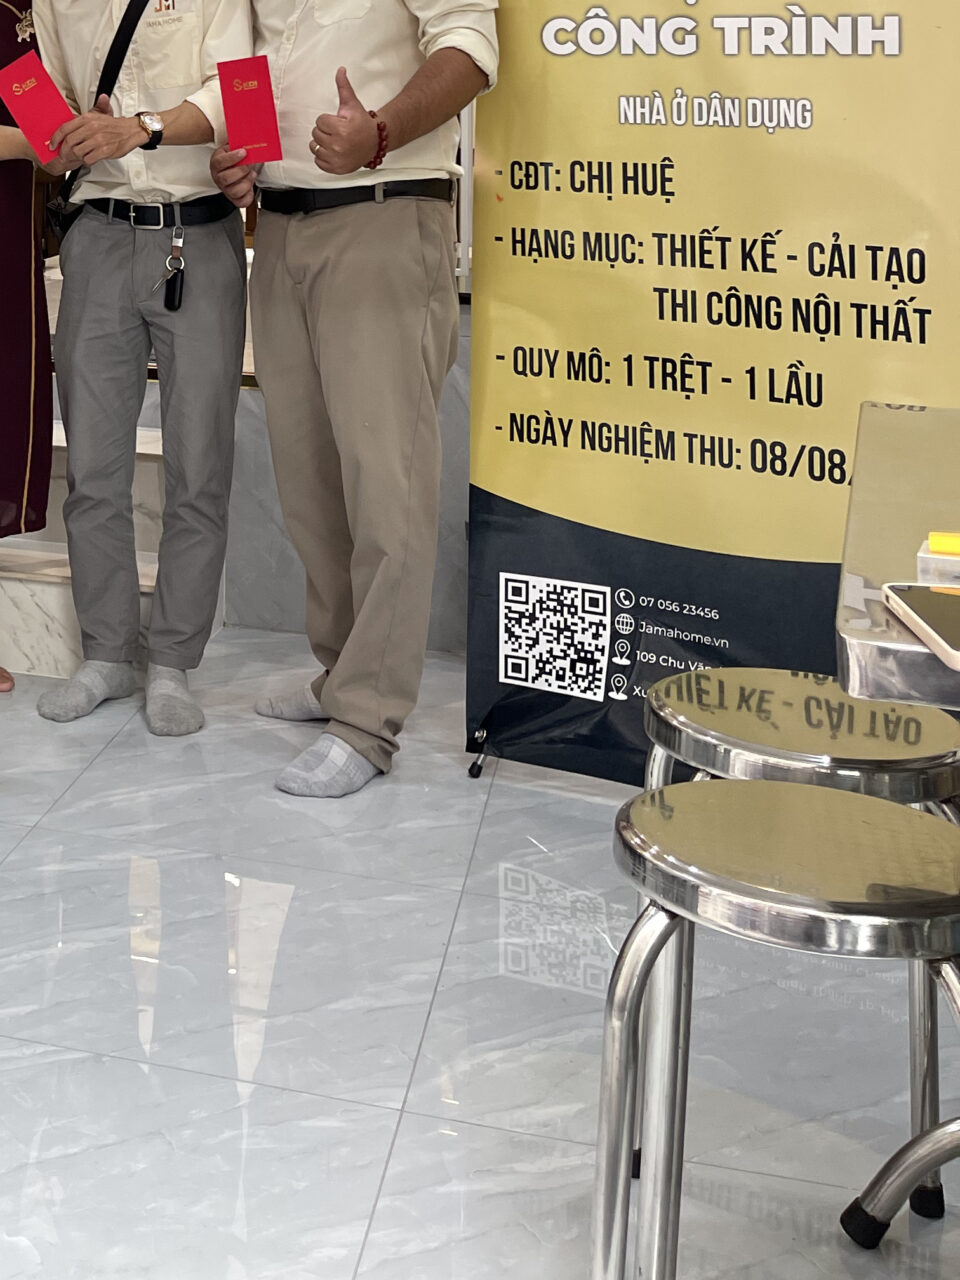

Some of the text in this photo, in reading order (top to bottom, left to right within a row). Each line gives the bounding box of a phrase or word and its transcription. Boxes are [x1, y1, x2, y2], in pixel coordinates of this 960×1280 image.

[541, 5, 901, 56] CÔNG TRÌNH
[619, 89, 813, 133] NHÀ Ở DÂN DỤNG
[511, 161, 560, 191] CĐT:
[570, 161, 612, 200] CHỊ
[622, 157, 674, 203] HUỆ
[512, 227, 574, 263] HẠNG
[583, 232, 643, 268] MỤC:
[652, 226, 731, 270] THIẾT
[741, 230, 782, 273] KẾ
[808, 232, 855, 279] CẢI
[865, 246, 925, 289] TẠO
[653, 286, 931, 344] THI CÔNG NỘI THẤT
[514, 346, 559, 378] QUY
[567, 347, 610, 384] MÔ:
[624, 354, 632, 386] 1
[644, 353, 712, 399] TRỆT
[746, 367, 755, 400] 1
[769, 360, 822, 407] LẦU
[509, 410, 573, 447] NGÀY
[580, 421, 676, 464] NGHIỆM
[683, 433, 742, 470] THU:
[640, 596, 720, 620] 07 056 23456
[639, 621, 730, 649] Jamahome.vn
[636, 650, 657, 664] 109
[659, 655, 685, 669] Chu
